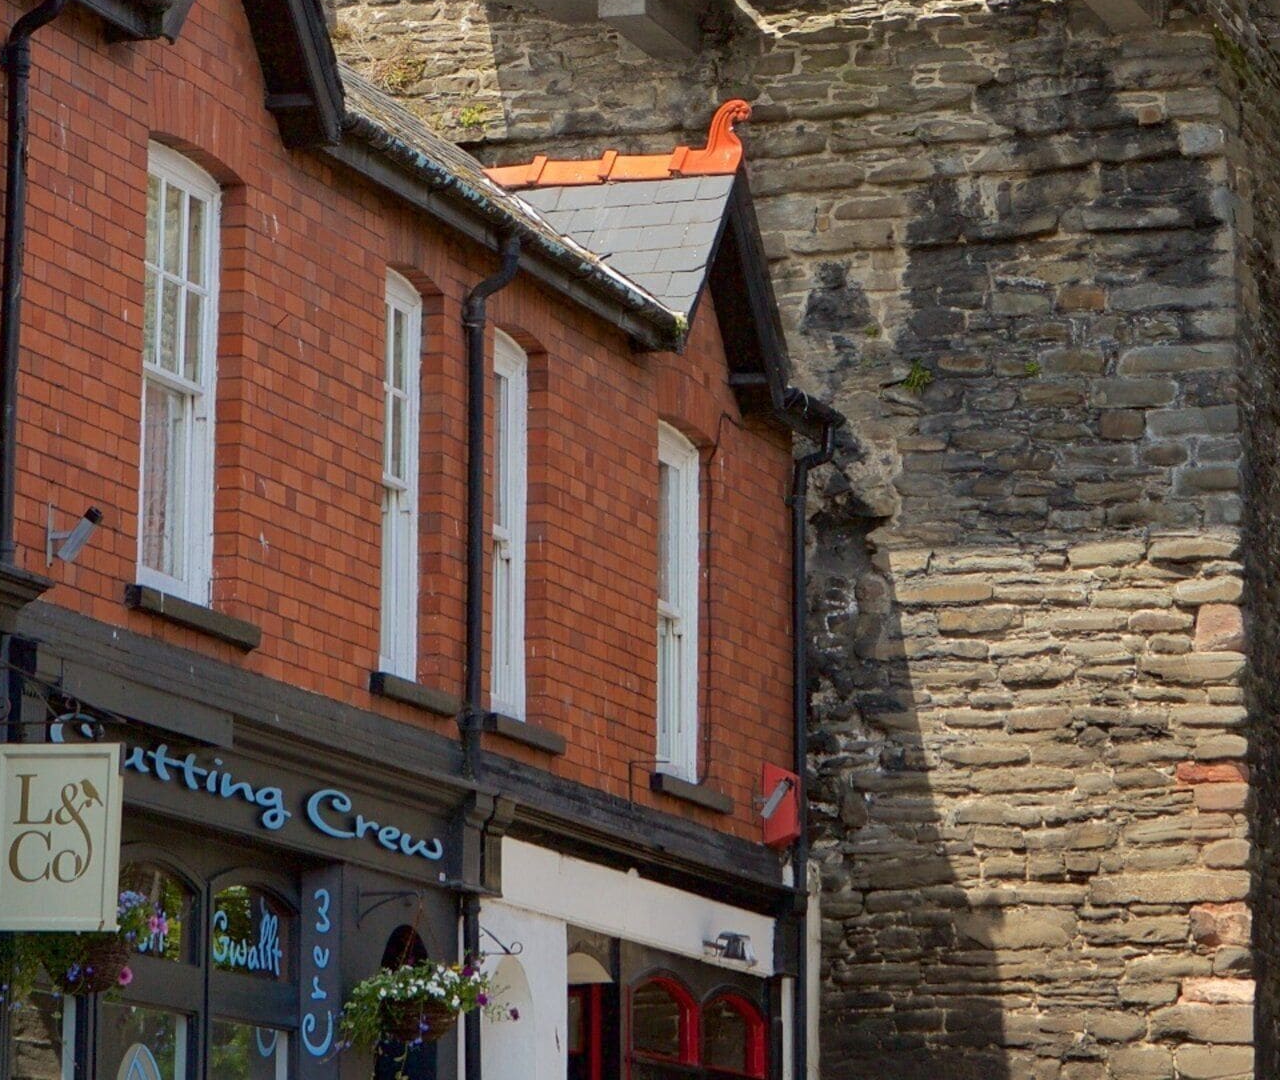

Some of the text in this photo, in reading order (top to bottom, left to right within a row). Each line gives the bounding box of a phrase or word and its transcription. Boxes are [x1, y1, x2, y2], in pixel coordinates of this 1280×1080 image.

[8, 830, 83, 883] Co
[307, 789, 443, 860] Crew
[302, 888, 333, 1056] Crew
